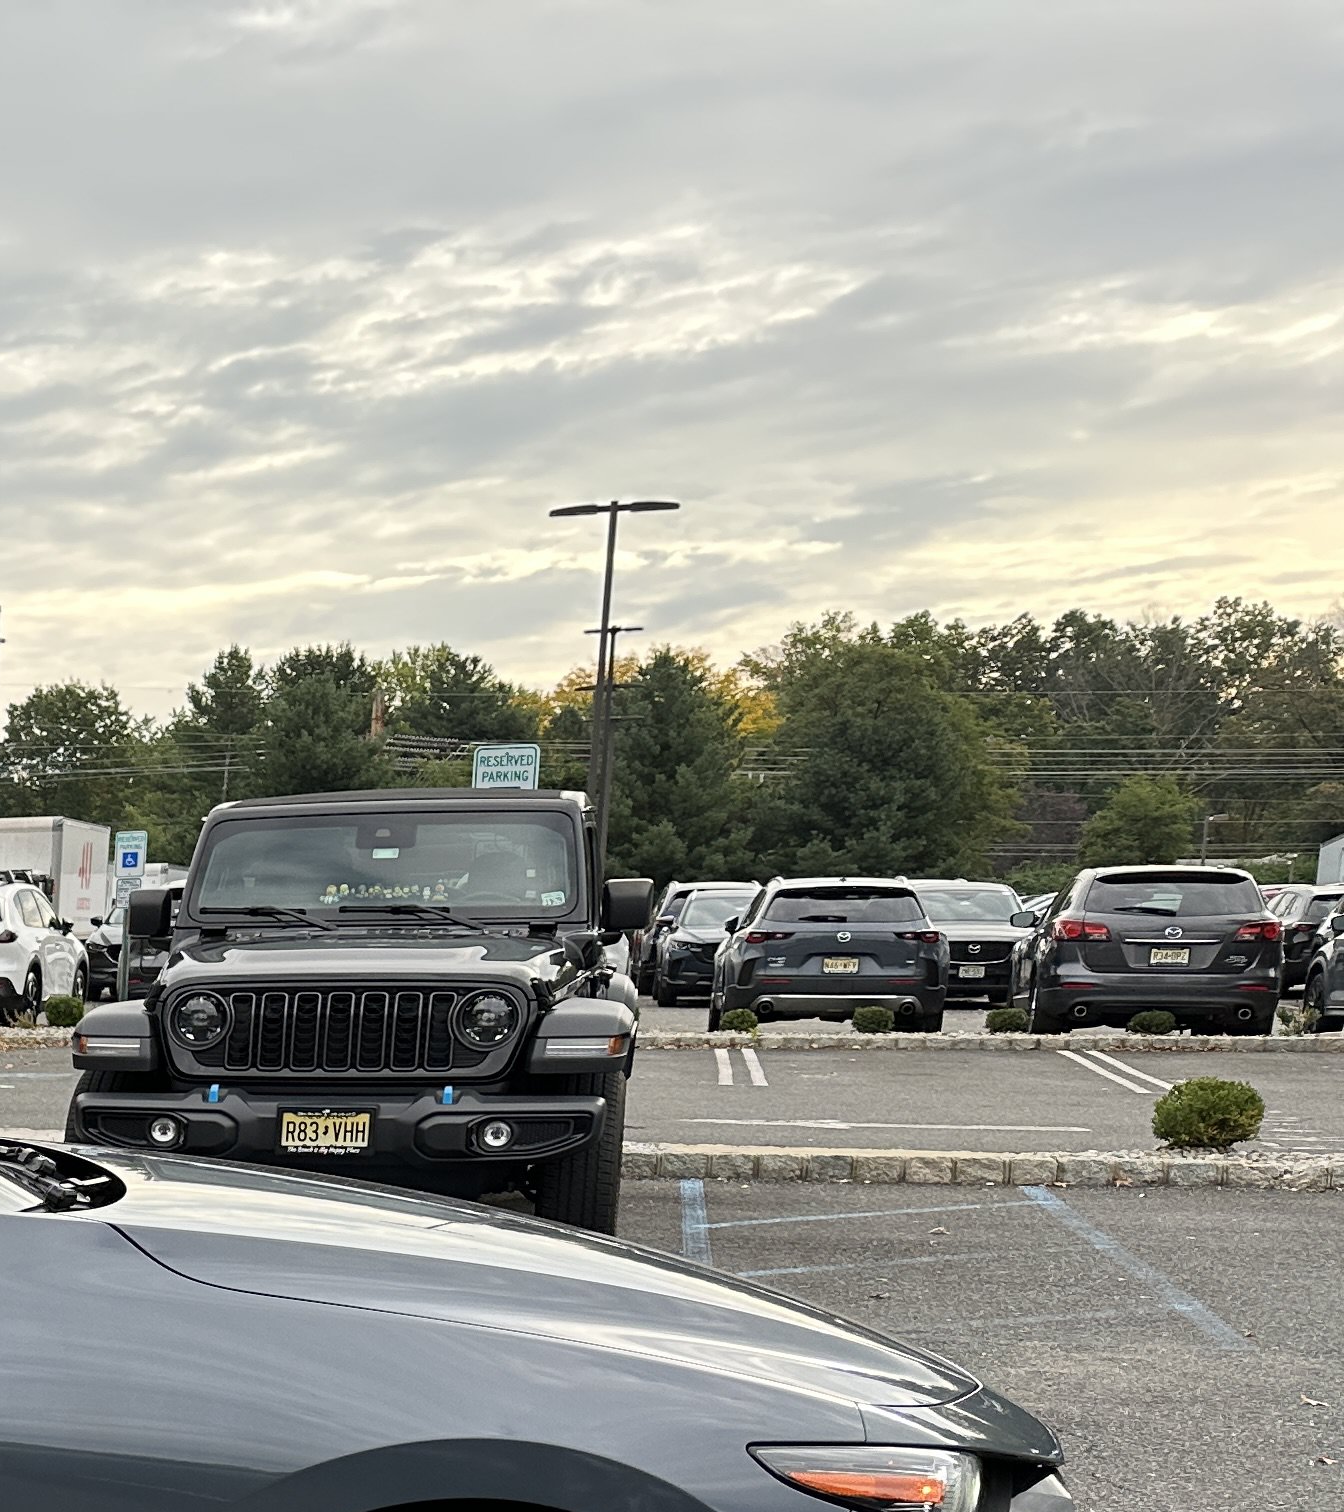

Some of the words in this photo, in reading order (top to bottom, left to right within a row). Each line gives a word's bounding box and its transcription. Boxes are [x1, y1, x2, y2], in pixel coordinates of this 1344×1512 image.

[479, 754, 533, 767] RESERVED
[481, 769, 529, 782] PARKING
[285, 1121, 319, 1143] R83
[333, 1121, 366, 1143] VHH
